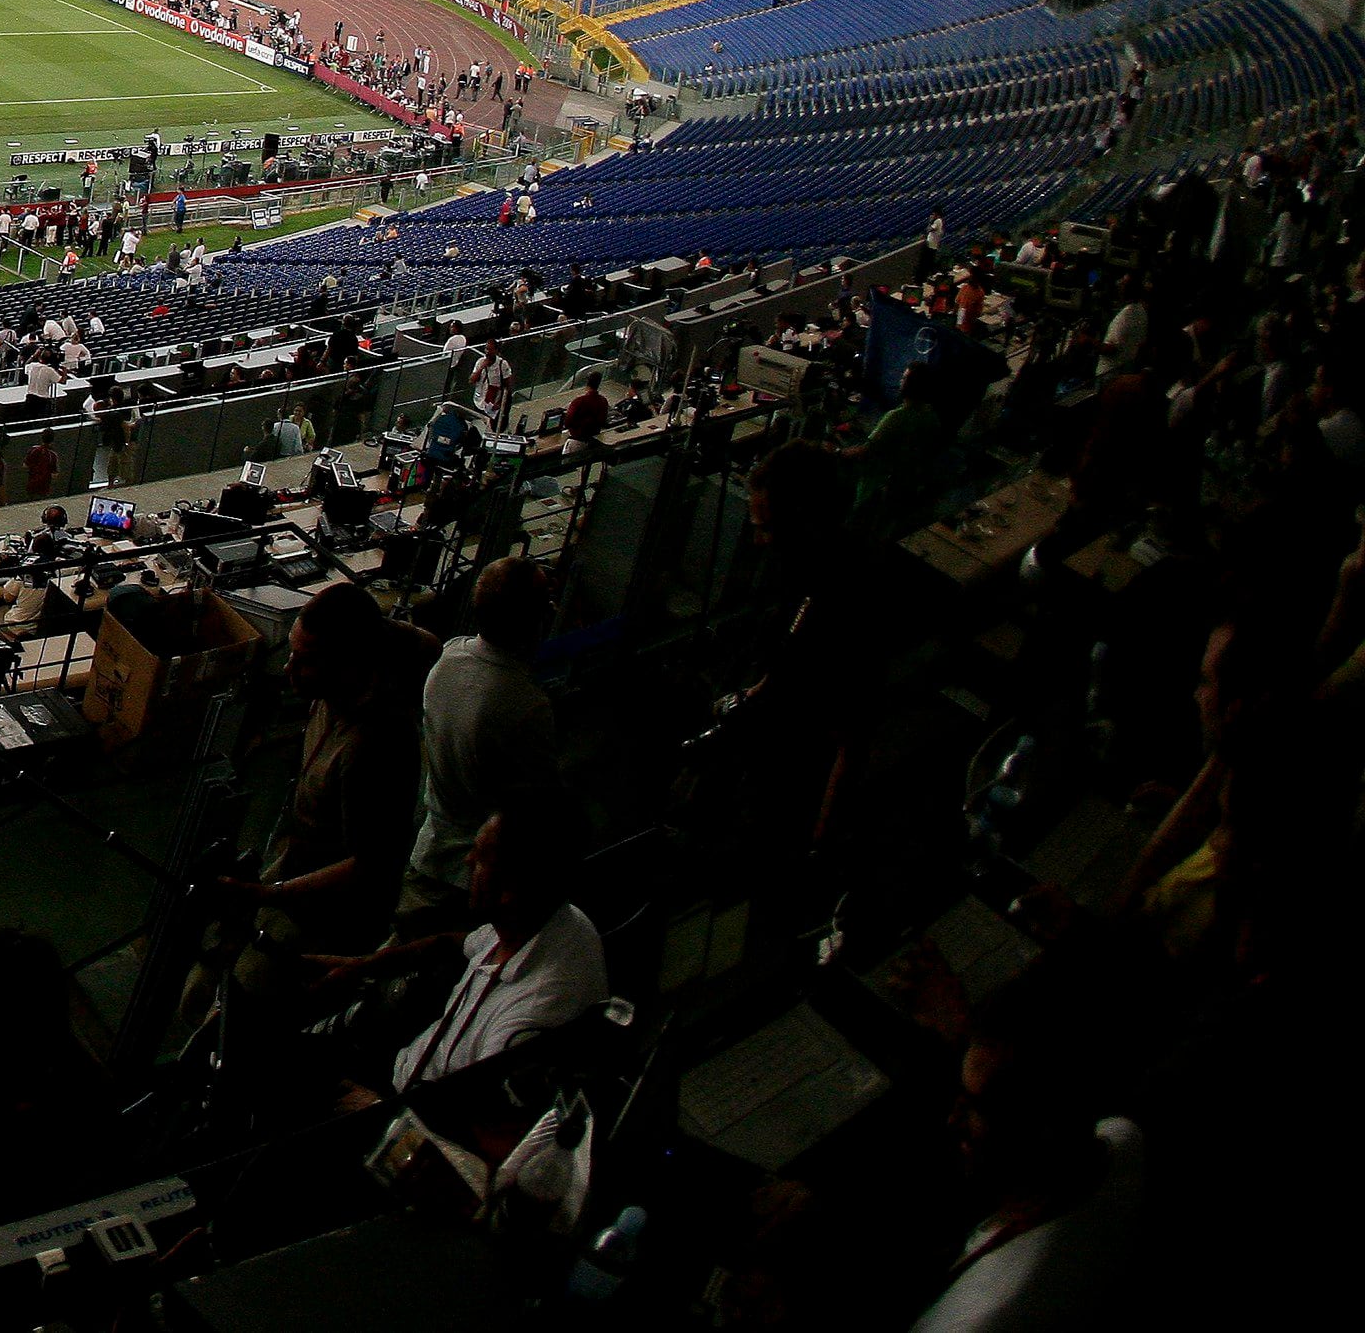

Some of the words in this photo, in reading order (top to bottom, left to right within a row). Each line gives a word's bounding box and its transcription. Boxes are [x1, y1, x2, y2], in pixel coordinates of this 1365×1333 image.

[144, 3, 186, 29] vodafone
[198, 27, 244, 52] vodafone
[283, 59, 309, 75] RESPECT
[363, 130, 394, 139] RESPECT
[230, 139, 264, 150] RESPECT
[22, 152, 64, 164] RESPECT
